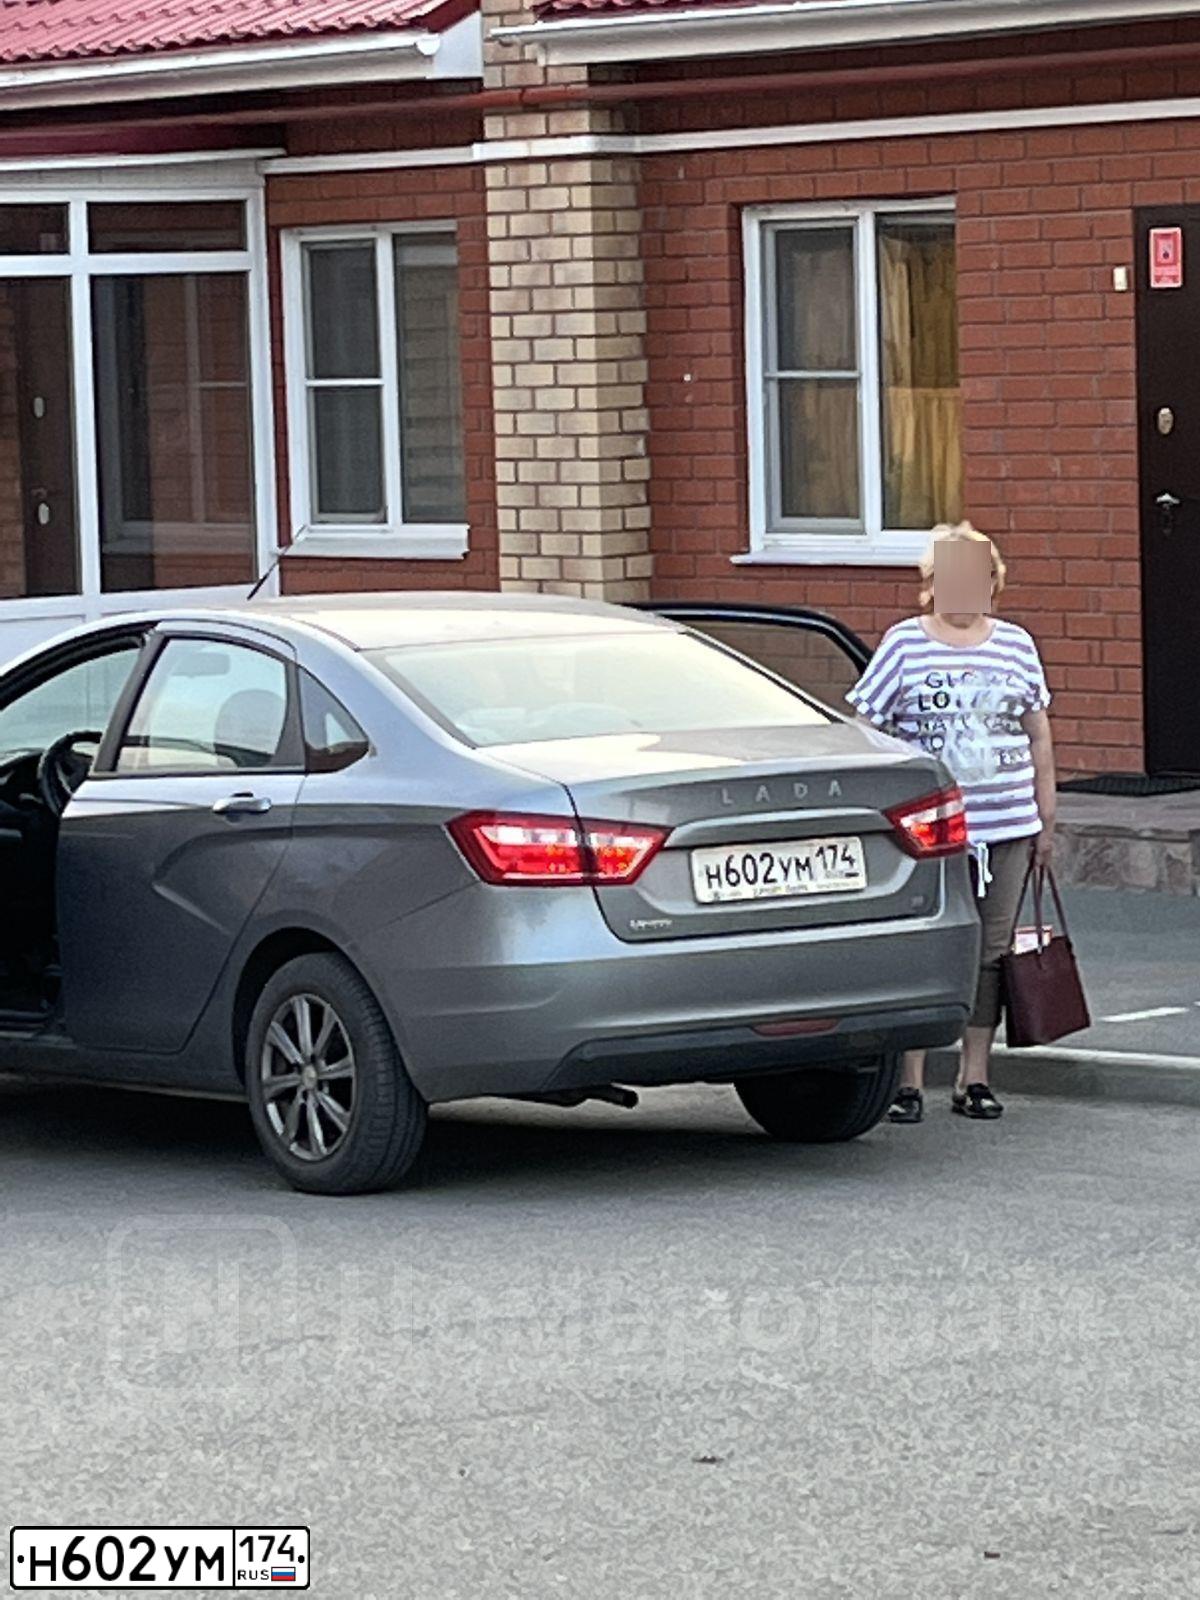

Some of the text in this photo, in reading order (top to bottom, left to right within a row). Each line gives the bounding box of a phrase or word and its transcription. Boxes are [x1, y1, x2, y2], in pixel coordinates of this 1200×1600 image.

[722, 780, 842, 804] LADA
[705, 844, 856, 889] Н602УМ 174
